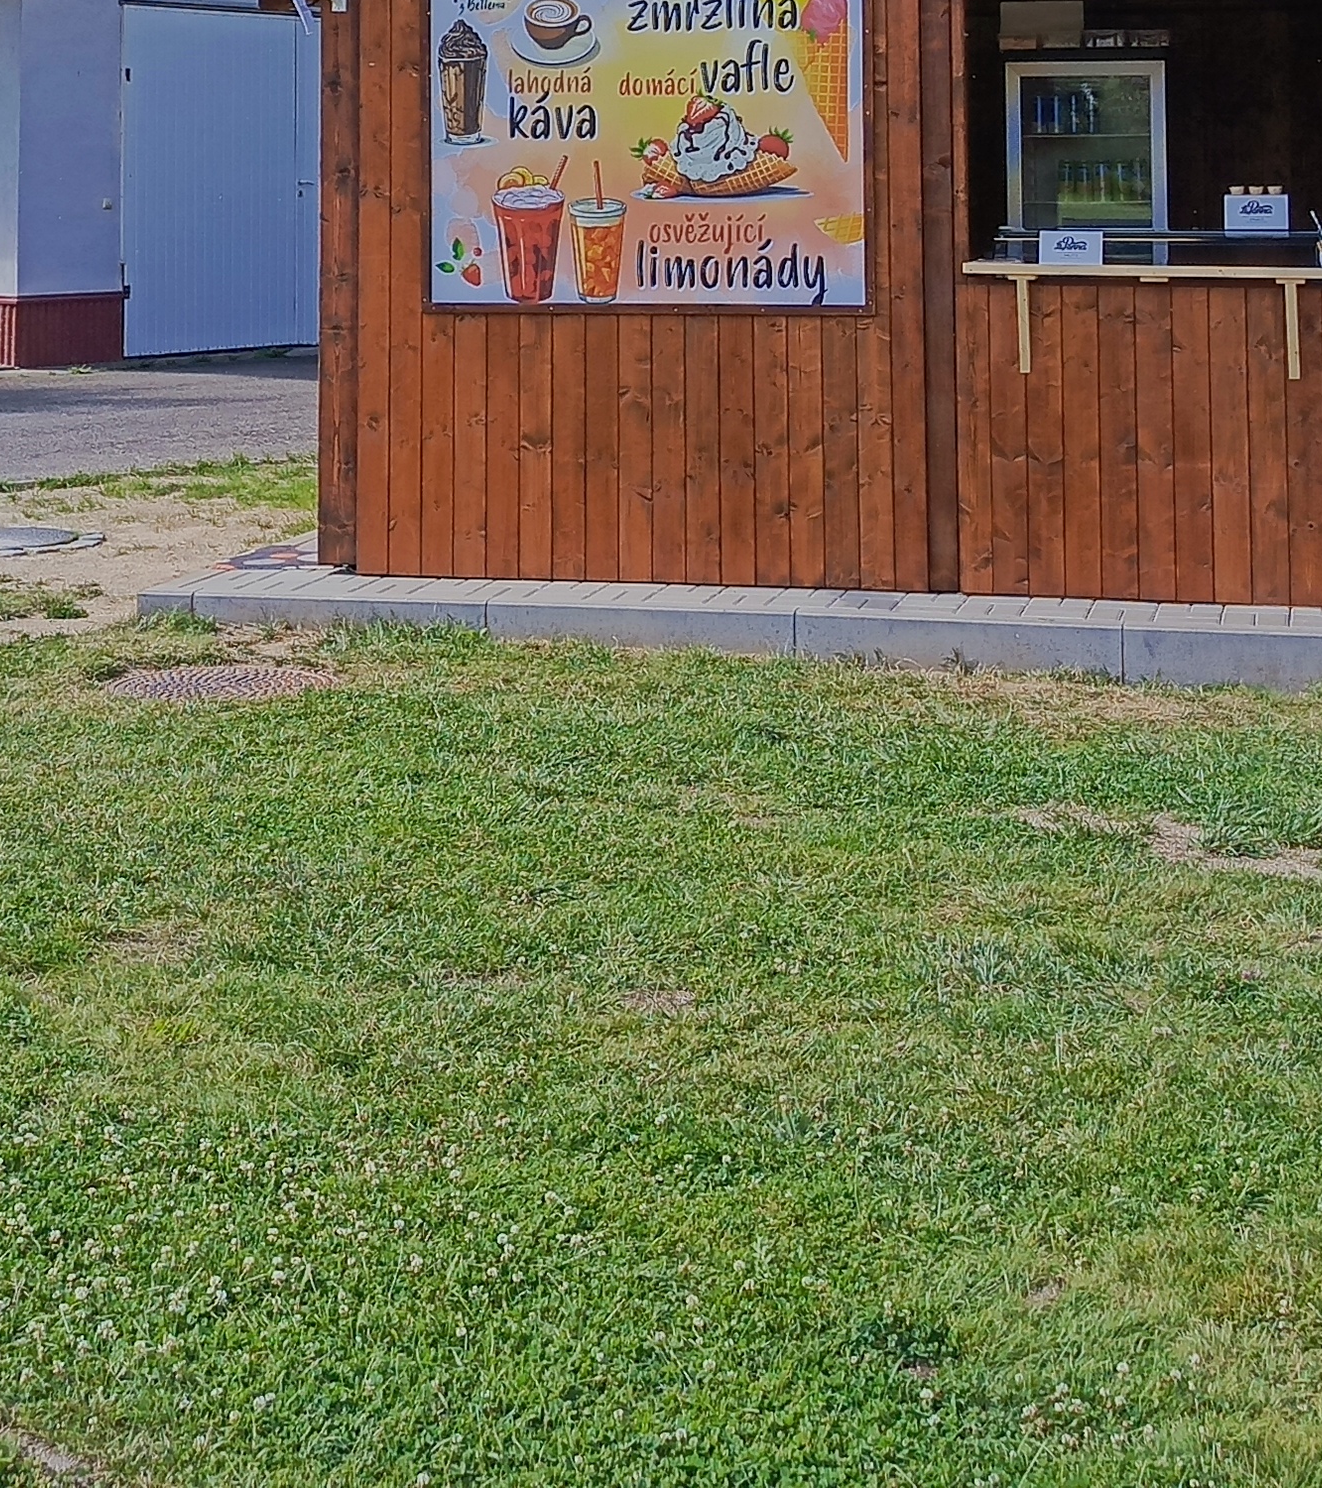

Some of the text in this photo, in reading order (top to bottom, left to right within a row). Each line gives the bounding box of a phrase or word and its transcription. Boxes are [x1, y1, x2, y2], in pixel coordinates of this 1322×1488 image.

[508, 66, 592, 94] lahodná
[619, 38, 795, 96] domácí vafle
[509, 92, 597, 140] káva
[649, 212, 767, 255] osvěžující
[636, 238, 829, 308] limonády
